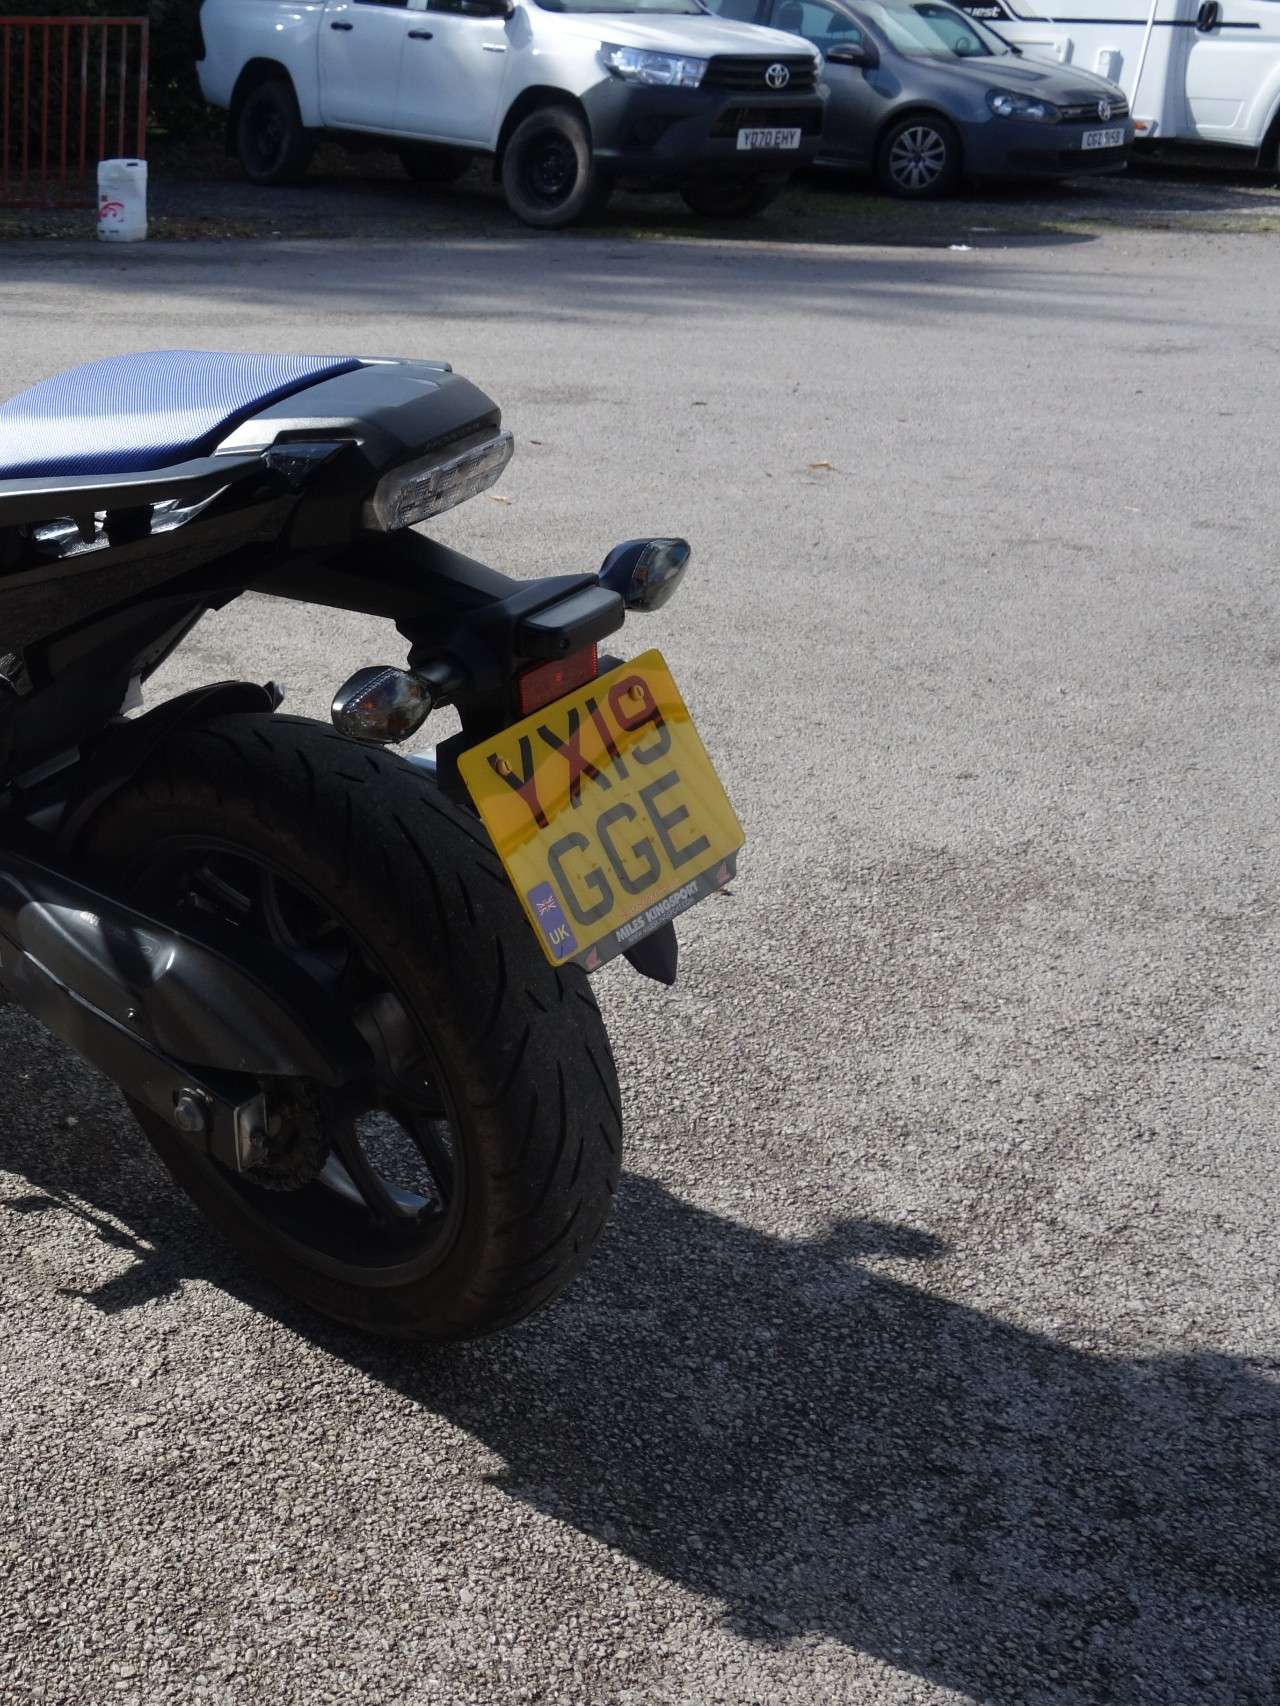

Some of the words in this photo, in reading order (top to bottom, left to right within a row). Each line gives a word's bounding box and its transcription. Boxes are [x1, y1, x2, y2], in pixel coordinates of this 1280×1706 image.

[486, 675, 672, 830] YX19
[547, 769, 712, 926] GGE
[548, 923, 571, 946] UK
[615, 915, 646, 943] MILES
[645, 880, 699, 923] KINGSPORT
